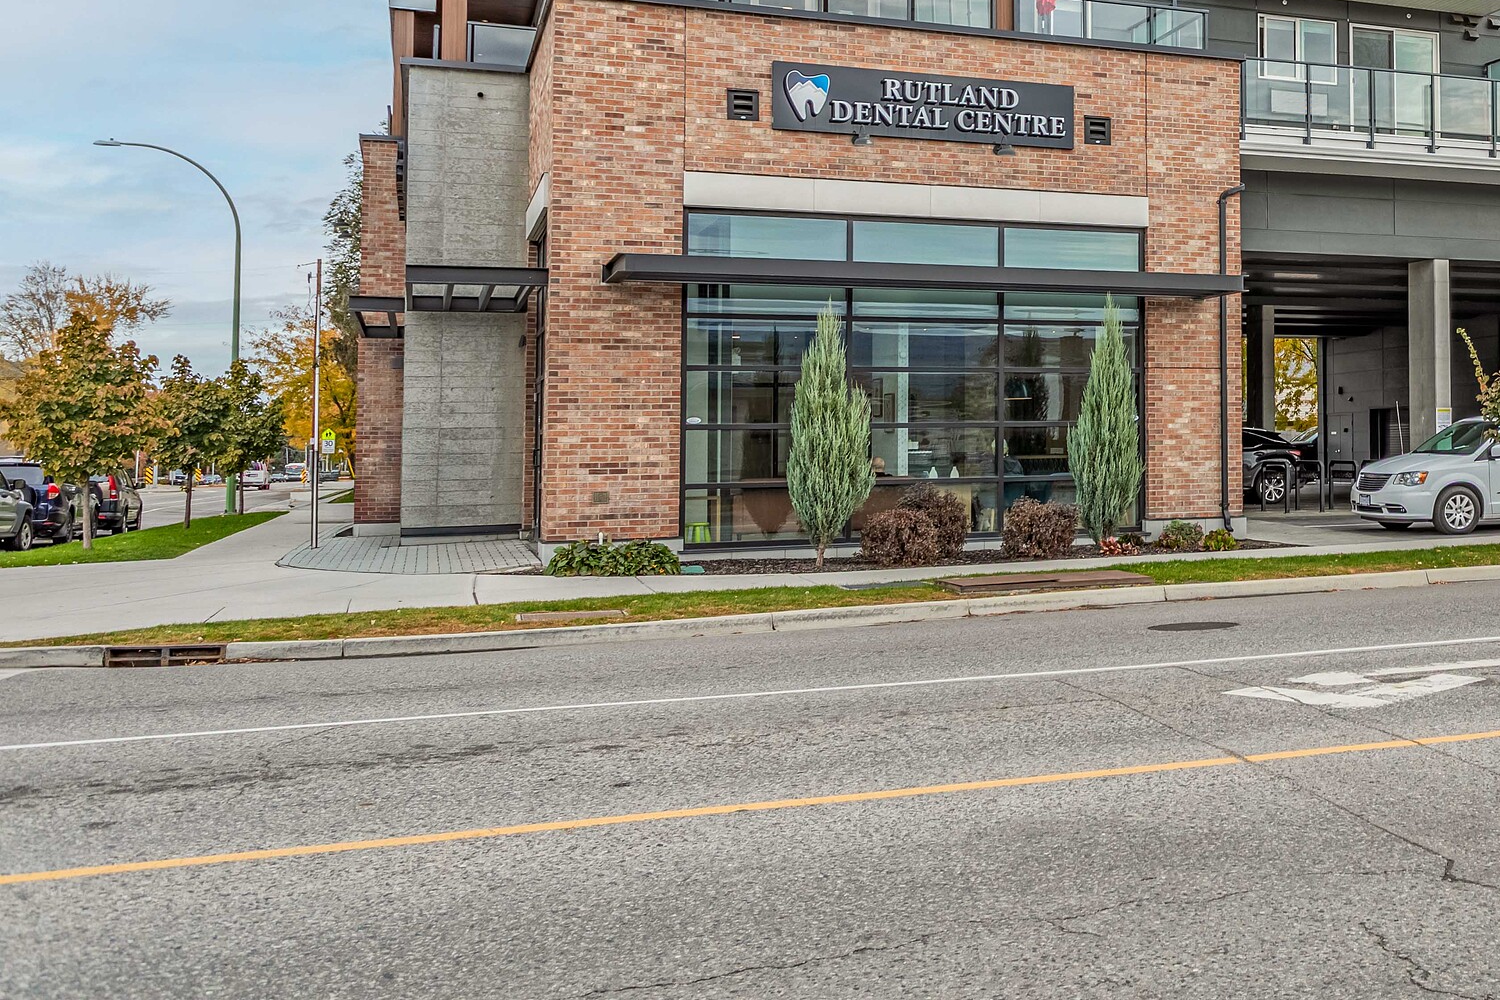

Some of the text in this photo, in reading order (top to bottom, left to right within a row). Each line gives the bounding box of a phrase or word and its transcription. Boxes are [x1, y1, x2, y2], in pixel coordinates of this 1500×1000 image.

[883, 78, 1020, 110] RUTLAND
[830, 100, 1067, 139] DENTAL CENTRE
